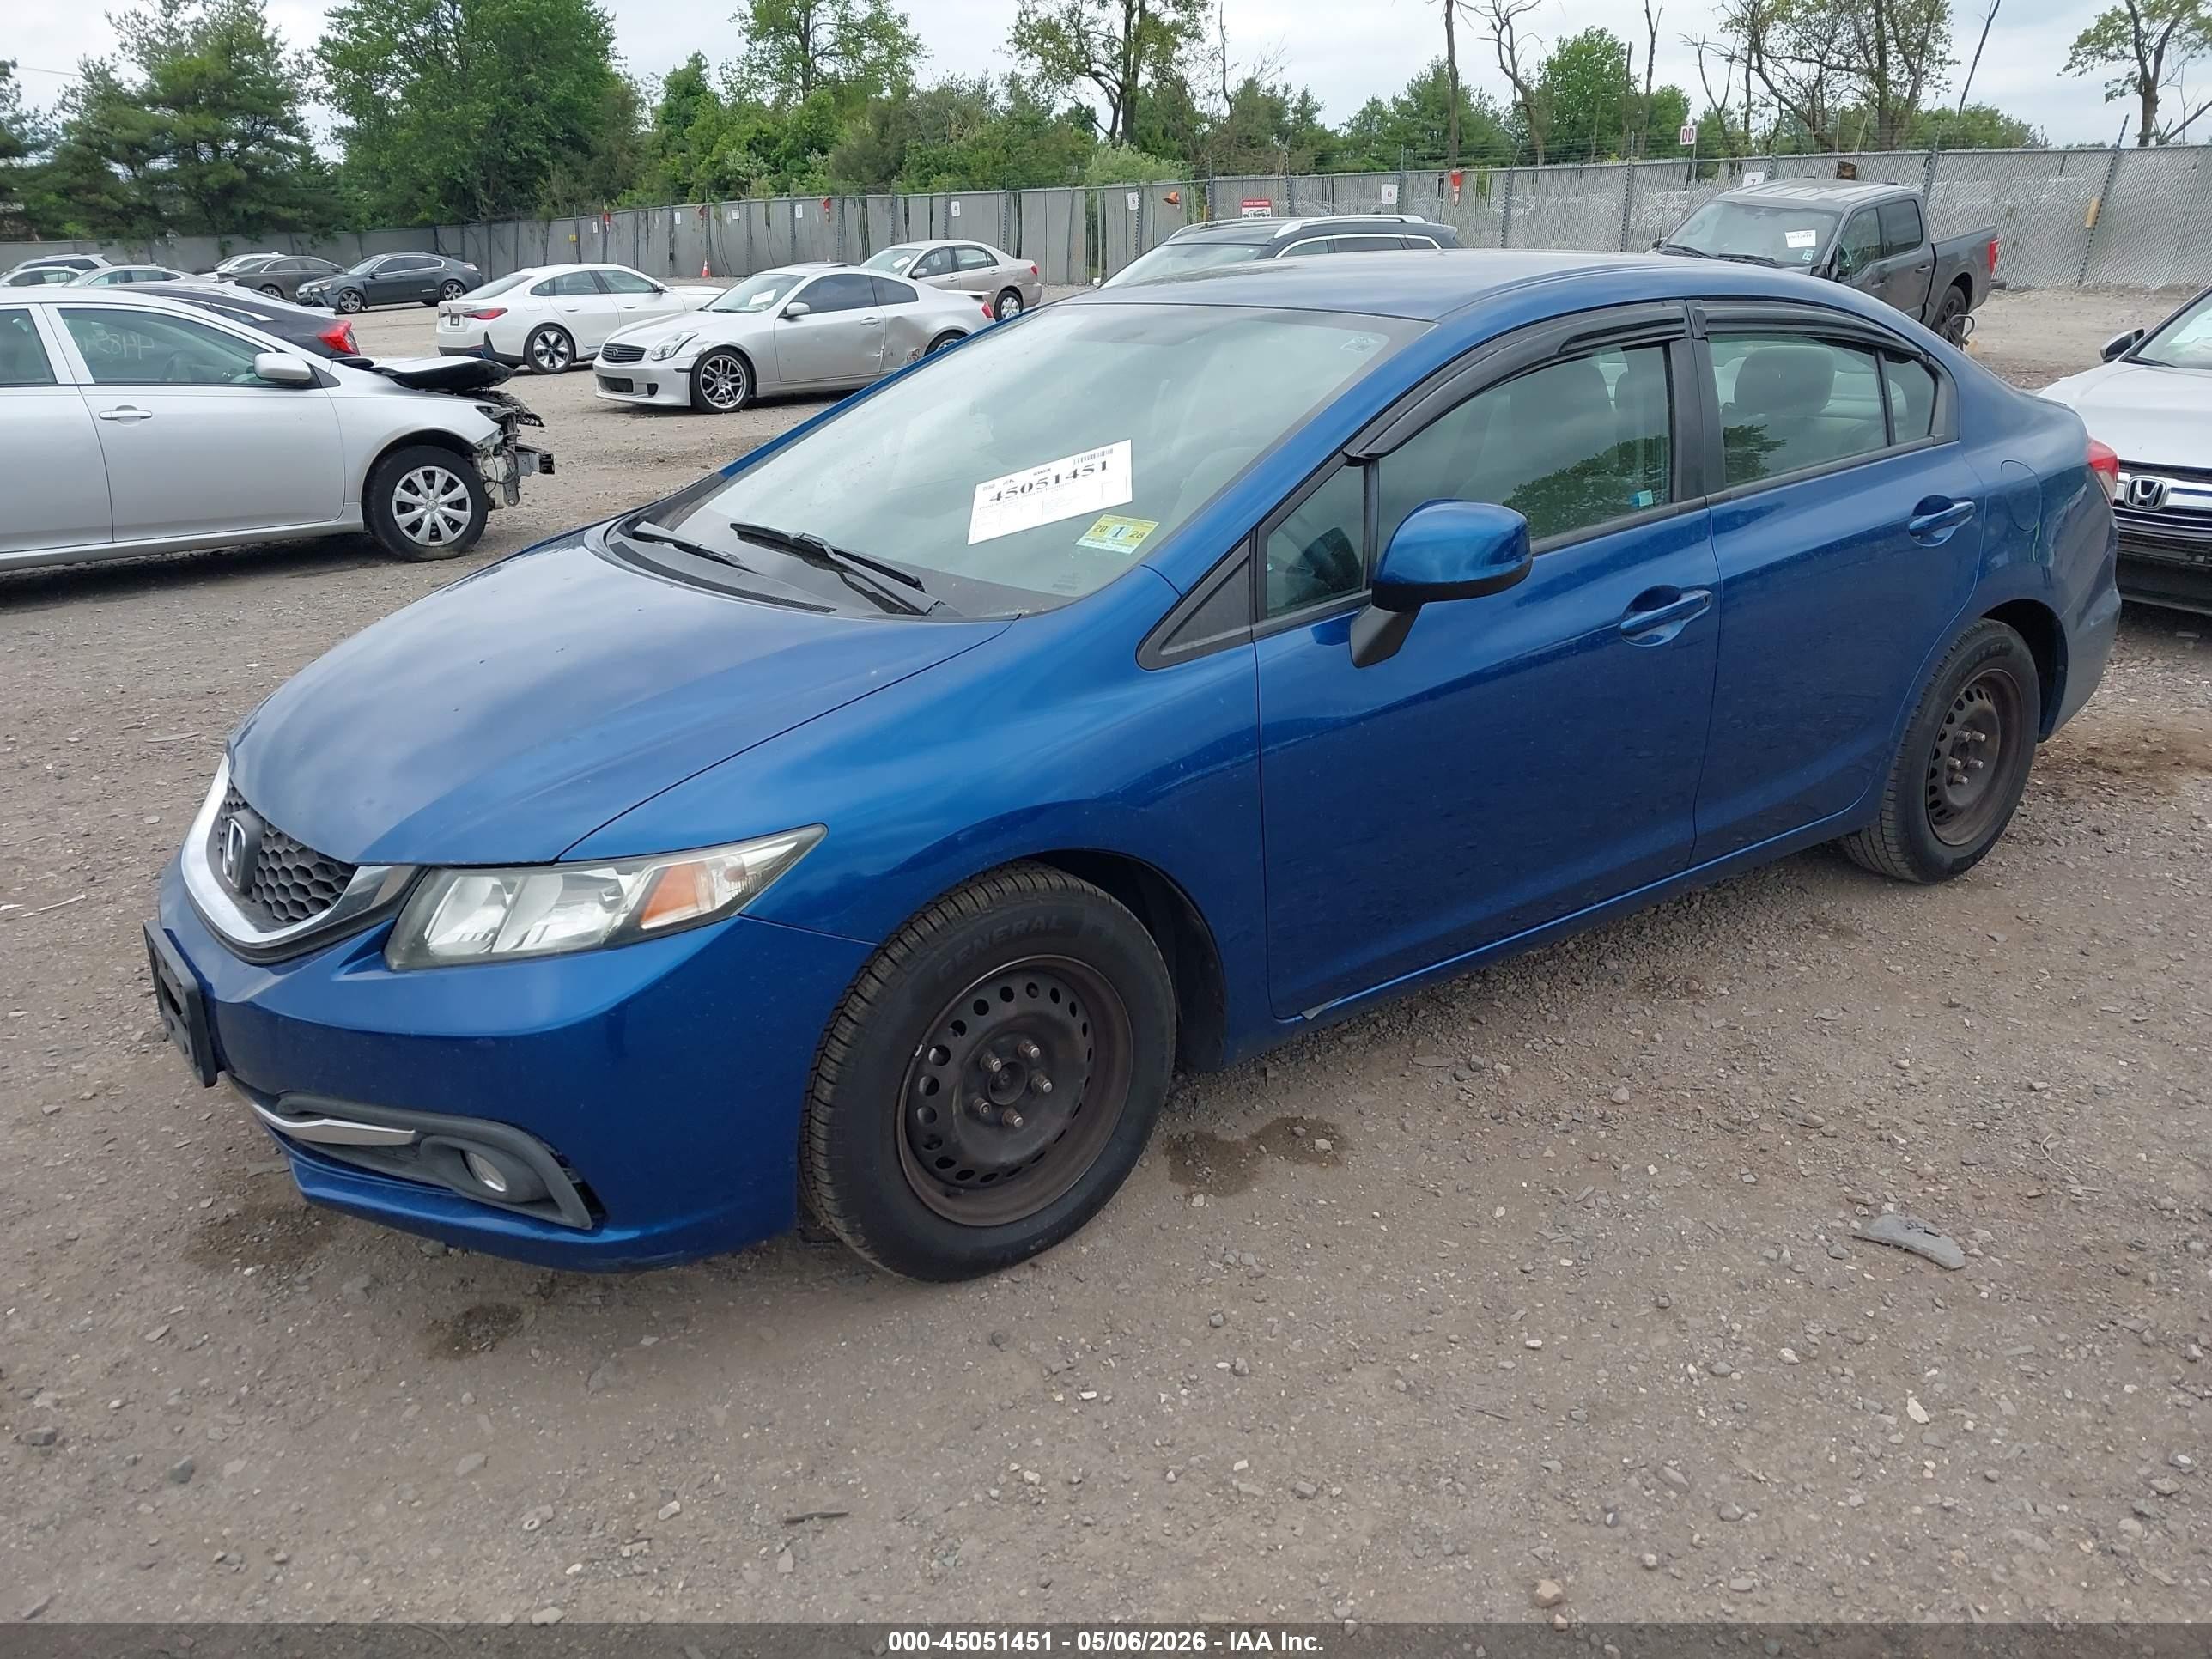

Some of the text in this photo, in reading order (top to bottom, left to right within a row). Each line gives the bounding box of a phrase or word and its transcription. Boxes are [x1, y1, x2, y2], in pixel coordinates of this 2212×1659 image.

[1682, 128, 1694, 143] DD
[988, 460, 1108, 503] 45051451
[939, 915, 1062, 976] GENERAL
